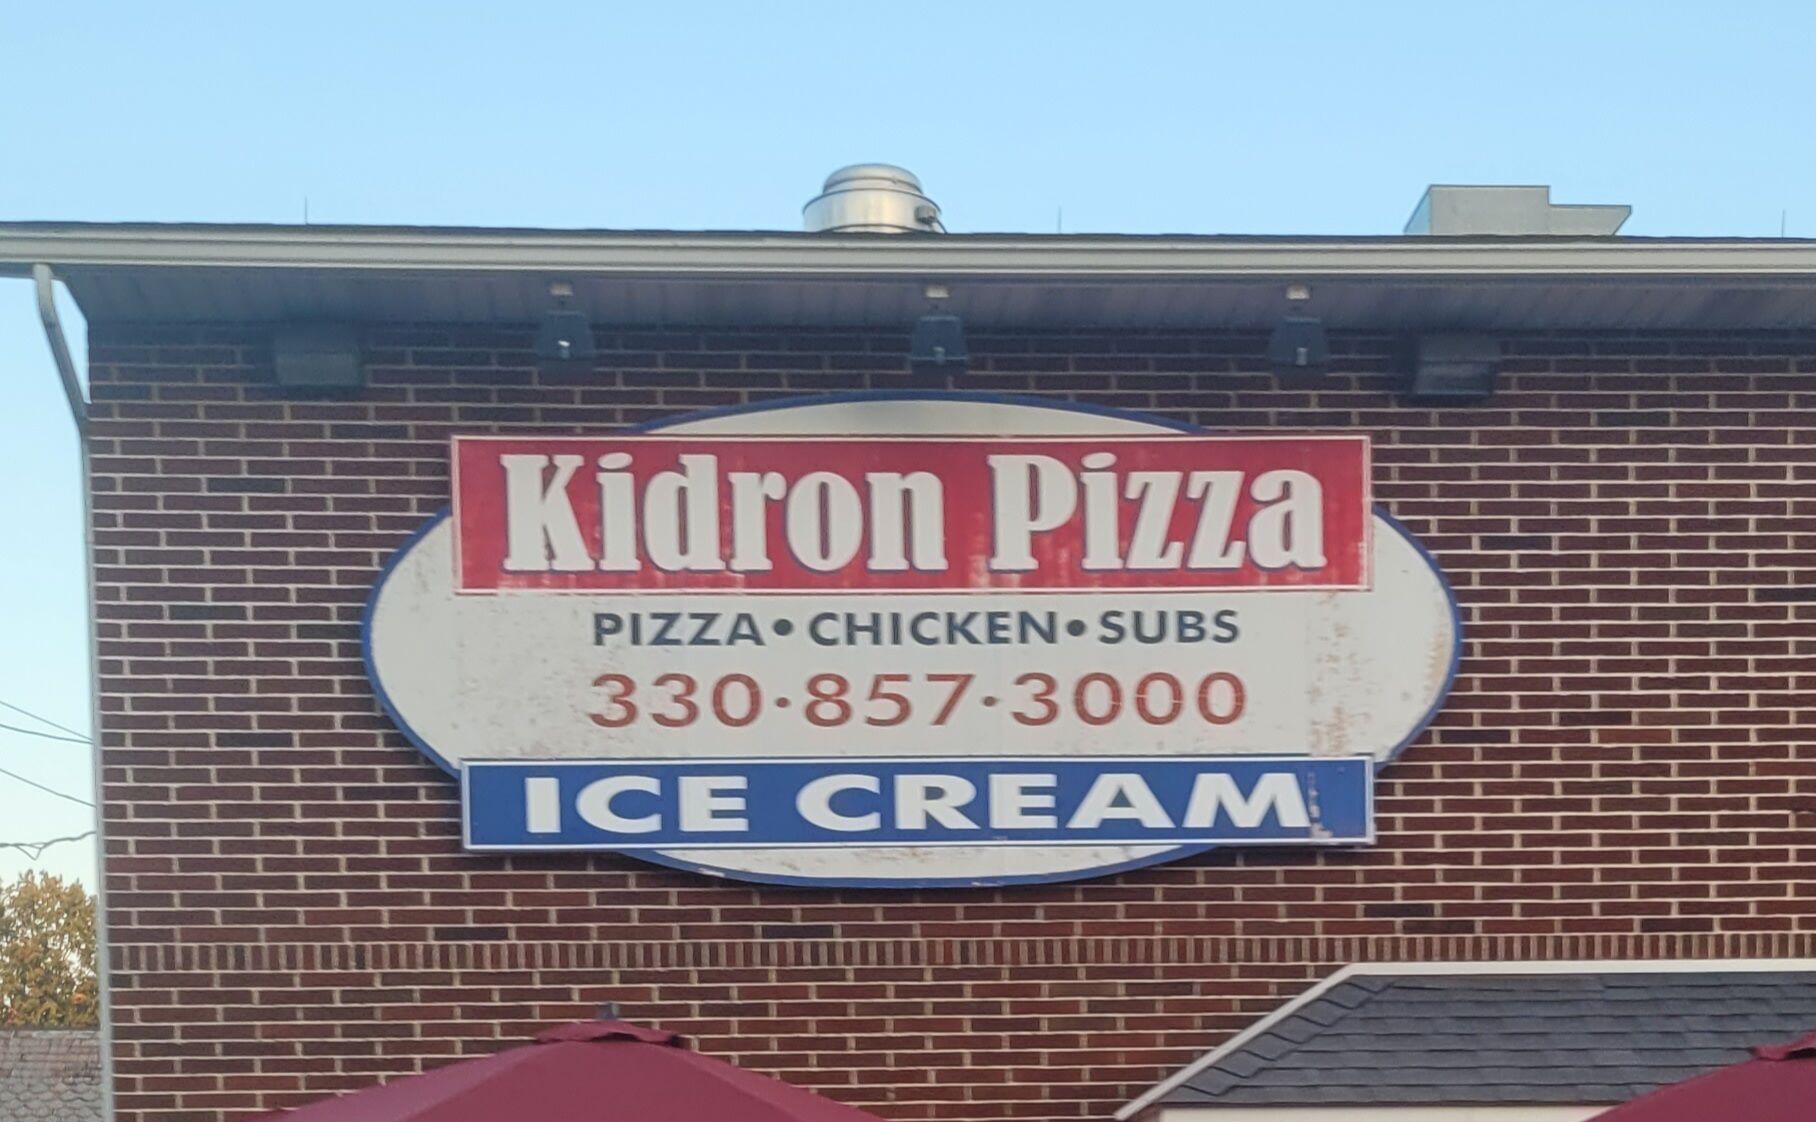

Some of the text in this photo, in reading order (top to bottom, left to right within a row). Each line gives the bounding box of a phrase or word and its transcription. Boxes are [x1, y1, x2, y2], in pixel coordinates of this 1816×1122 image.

[500, 452, 1328, 572] Kidron Pizza
[524, 772, 1312, 834] ICE CREAM
